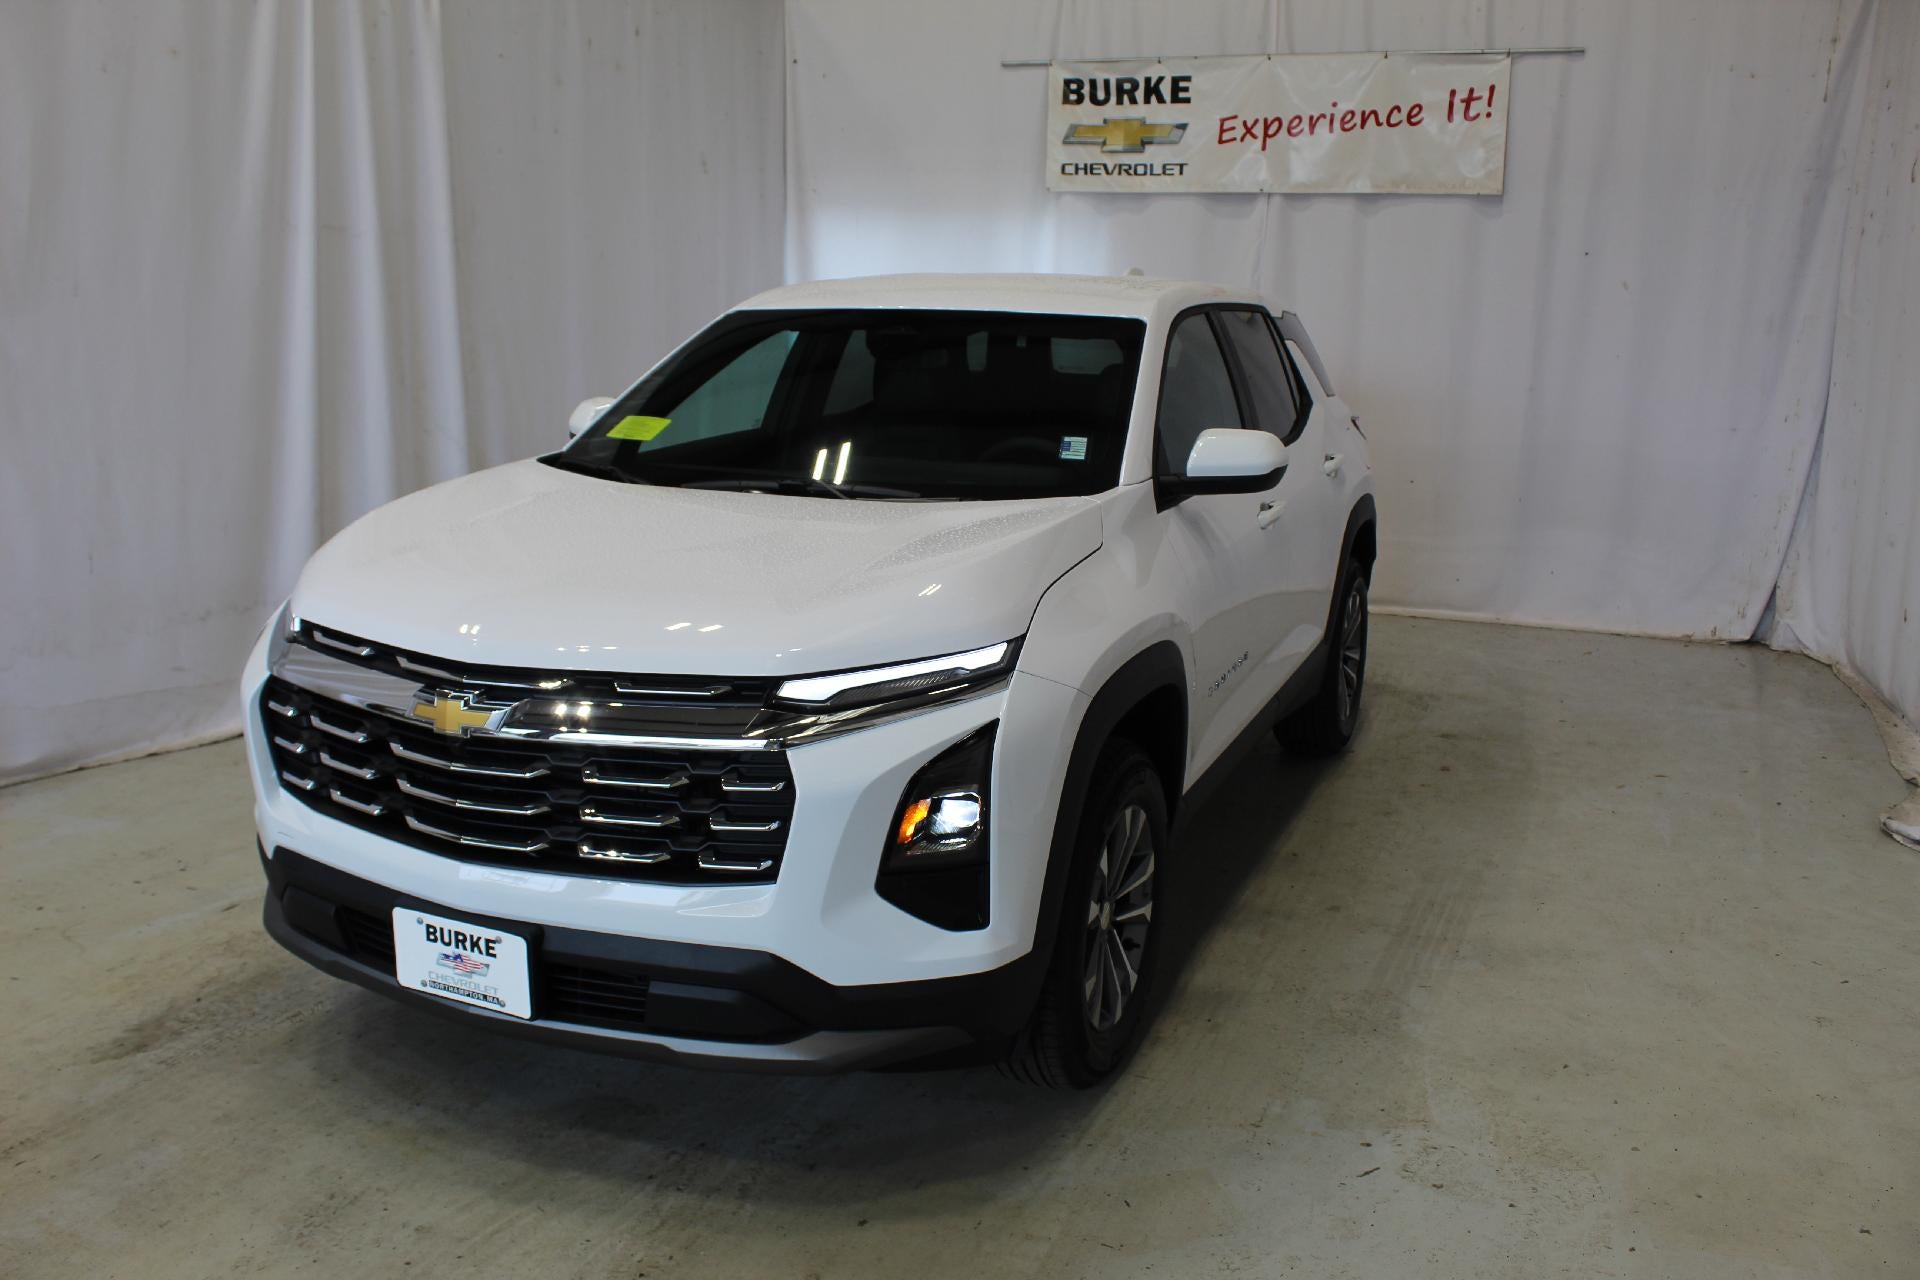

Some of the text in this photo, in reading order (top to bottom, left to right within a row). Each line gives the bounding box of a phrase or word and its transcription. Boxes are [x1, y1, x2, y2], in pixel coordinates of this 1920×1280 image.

[1062, 76, 1192, 106] BURKE
[1217, 84, 1496, 151] Experience It!
[1060, 162, 1189, 177] CHEVROLET
[426, 924, 497, 958] BURKE
